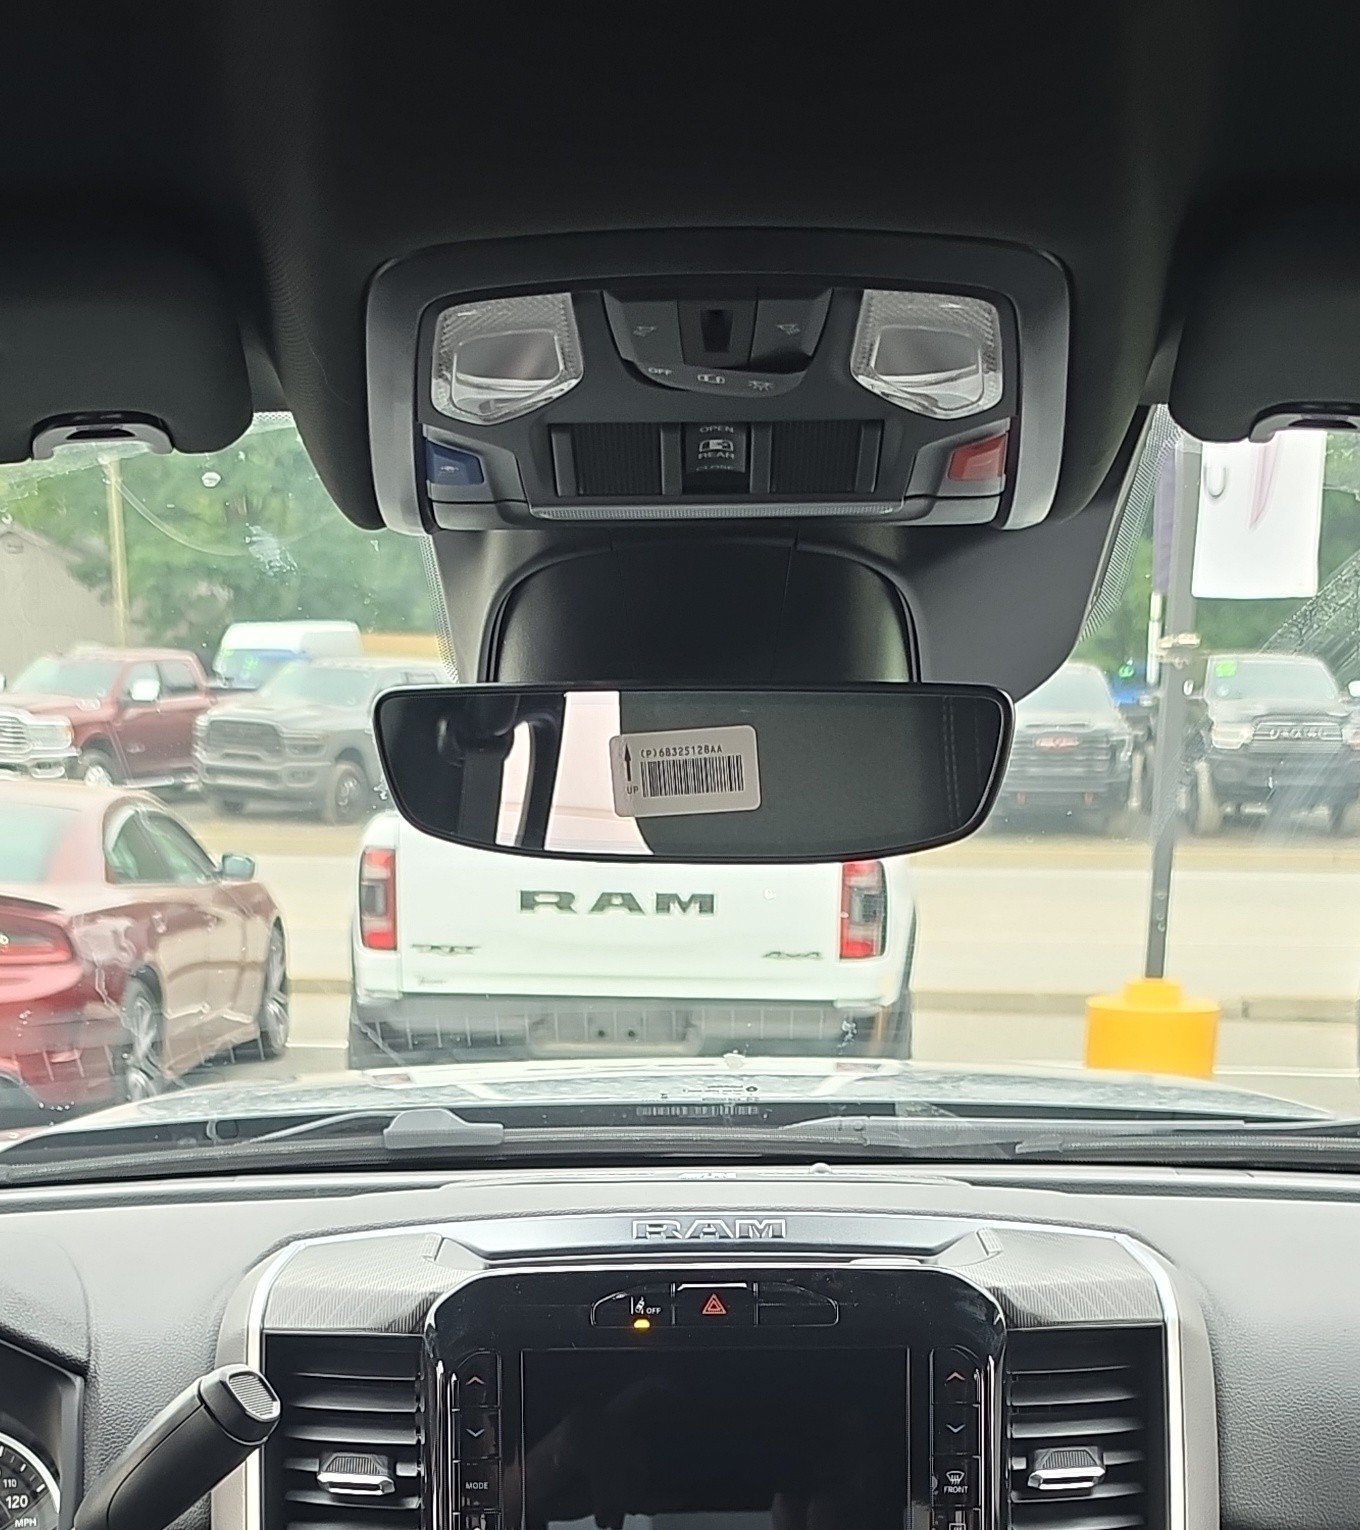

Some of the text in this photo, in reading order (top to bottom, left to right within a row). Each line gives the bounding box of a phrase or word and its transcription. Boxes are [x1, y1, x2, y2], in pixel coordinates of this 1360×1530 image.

[648, 366, 672, 375] OFF
[700, 425, 734, 433] OPEN
[698, 451, 735, 460] REAR
[626, 785, 639, 795] UP
[520, 889, 715, 915] RAM
[632, 1219, 786, 1239] RAM
[646, 1307, 661, 1315] OFF
[3, 1478, 17, 1488] 110
[465, 1481, 489, 1490] MODE
[943, 1485, 969, 1493] FRONT
[5, 1494, 29, 1509] 120
[14, 1517, 37, 1528] MPH
